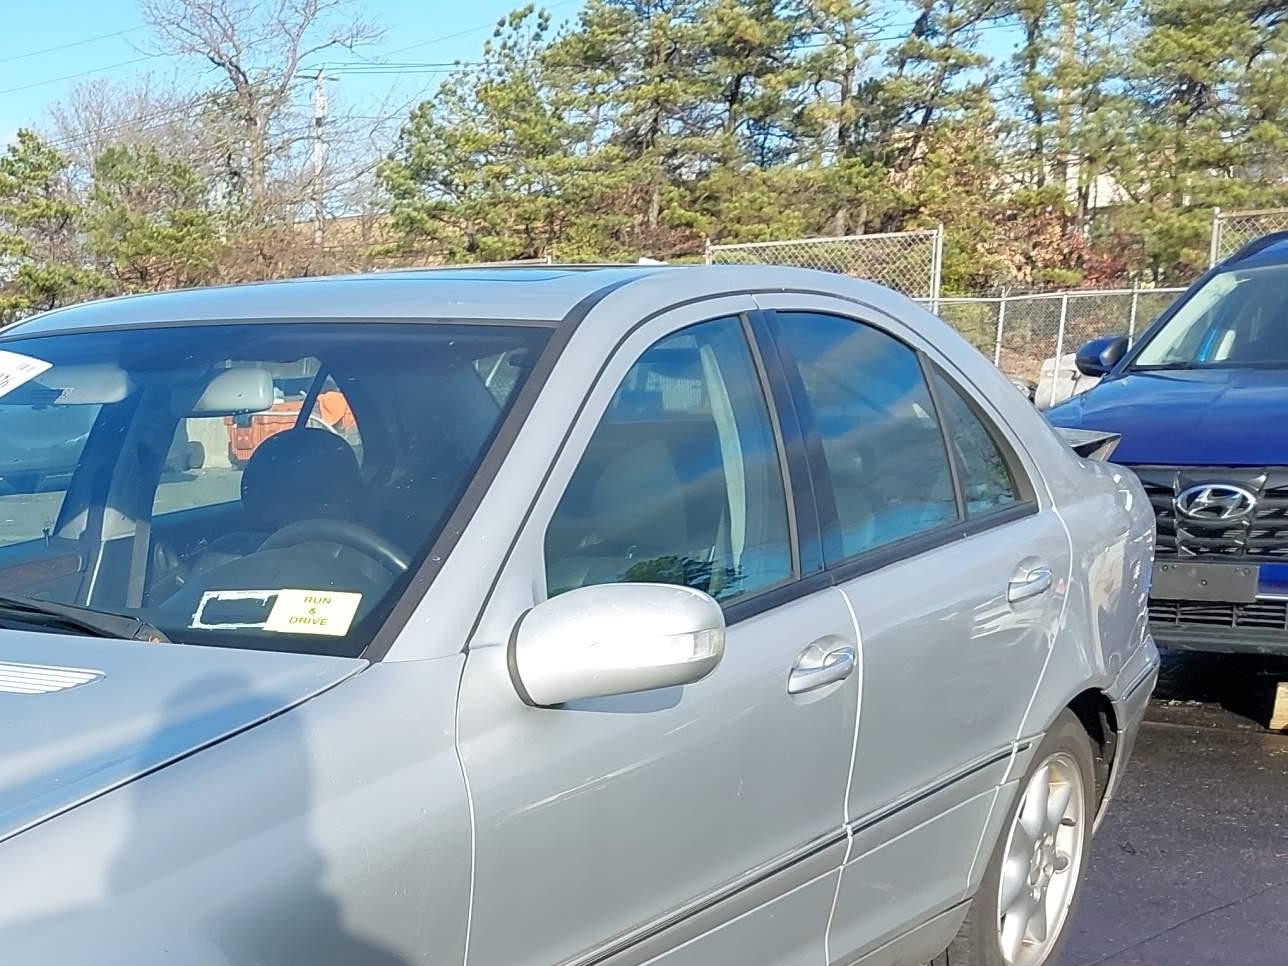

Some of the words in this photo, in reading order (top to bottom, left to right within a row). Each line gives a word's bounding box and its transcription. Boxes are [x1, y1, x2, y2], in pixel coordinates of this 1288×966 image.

[304, 596, 332, 605] RUN
[308, 607, 317, 615] &
[289, 616, 329, 626] DRIVE
